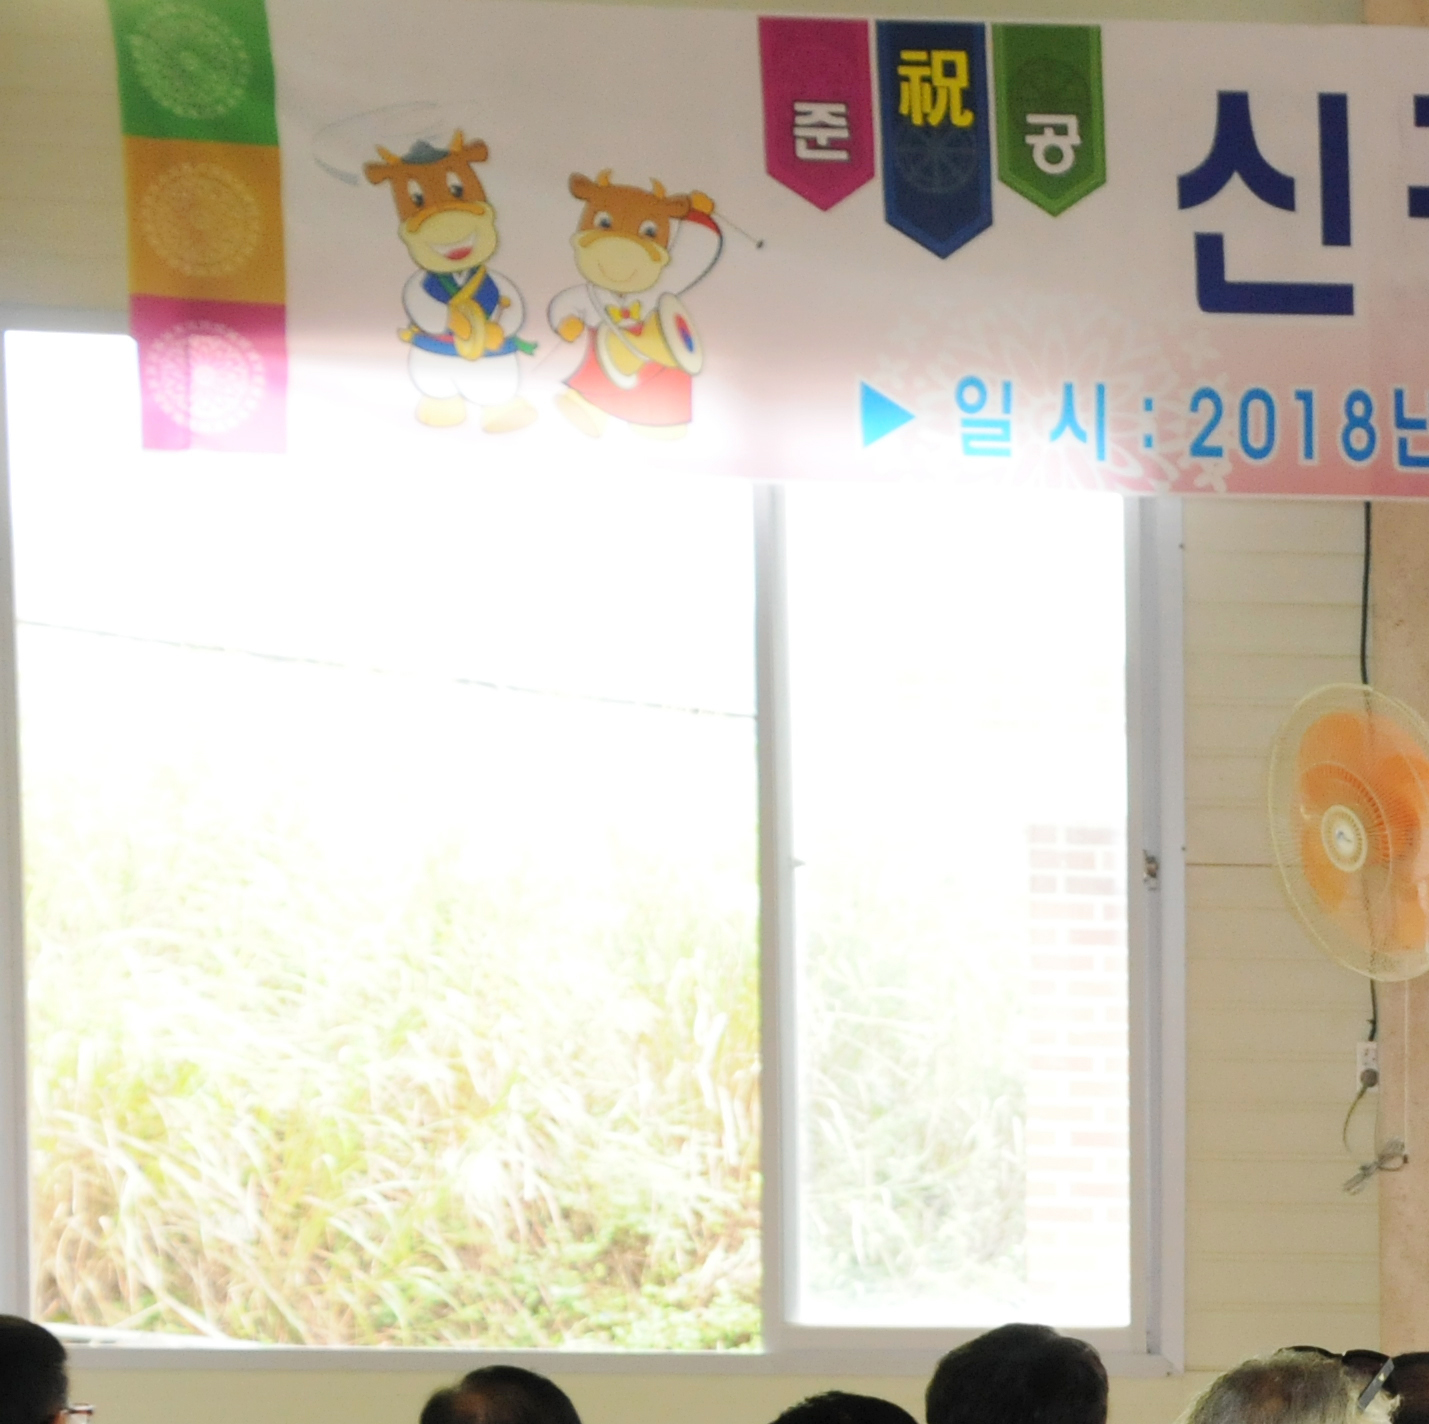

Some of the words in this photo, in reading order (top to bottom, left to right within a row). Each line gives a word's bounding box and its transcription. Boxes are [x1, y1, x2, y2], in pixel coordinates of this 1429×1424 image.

[897, 49, 974, 129] 祝
[792, 100, 850, 162] 준
[1024, 112, 1082, 176] 공
